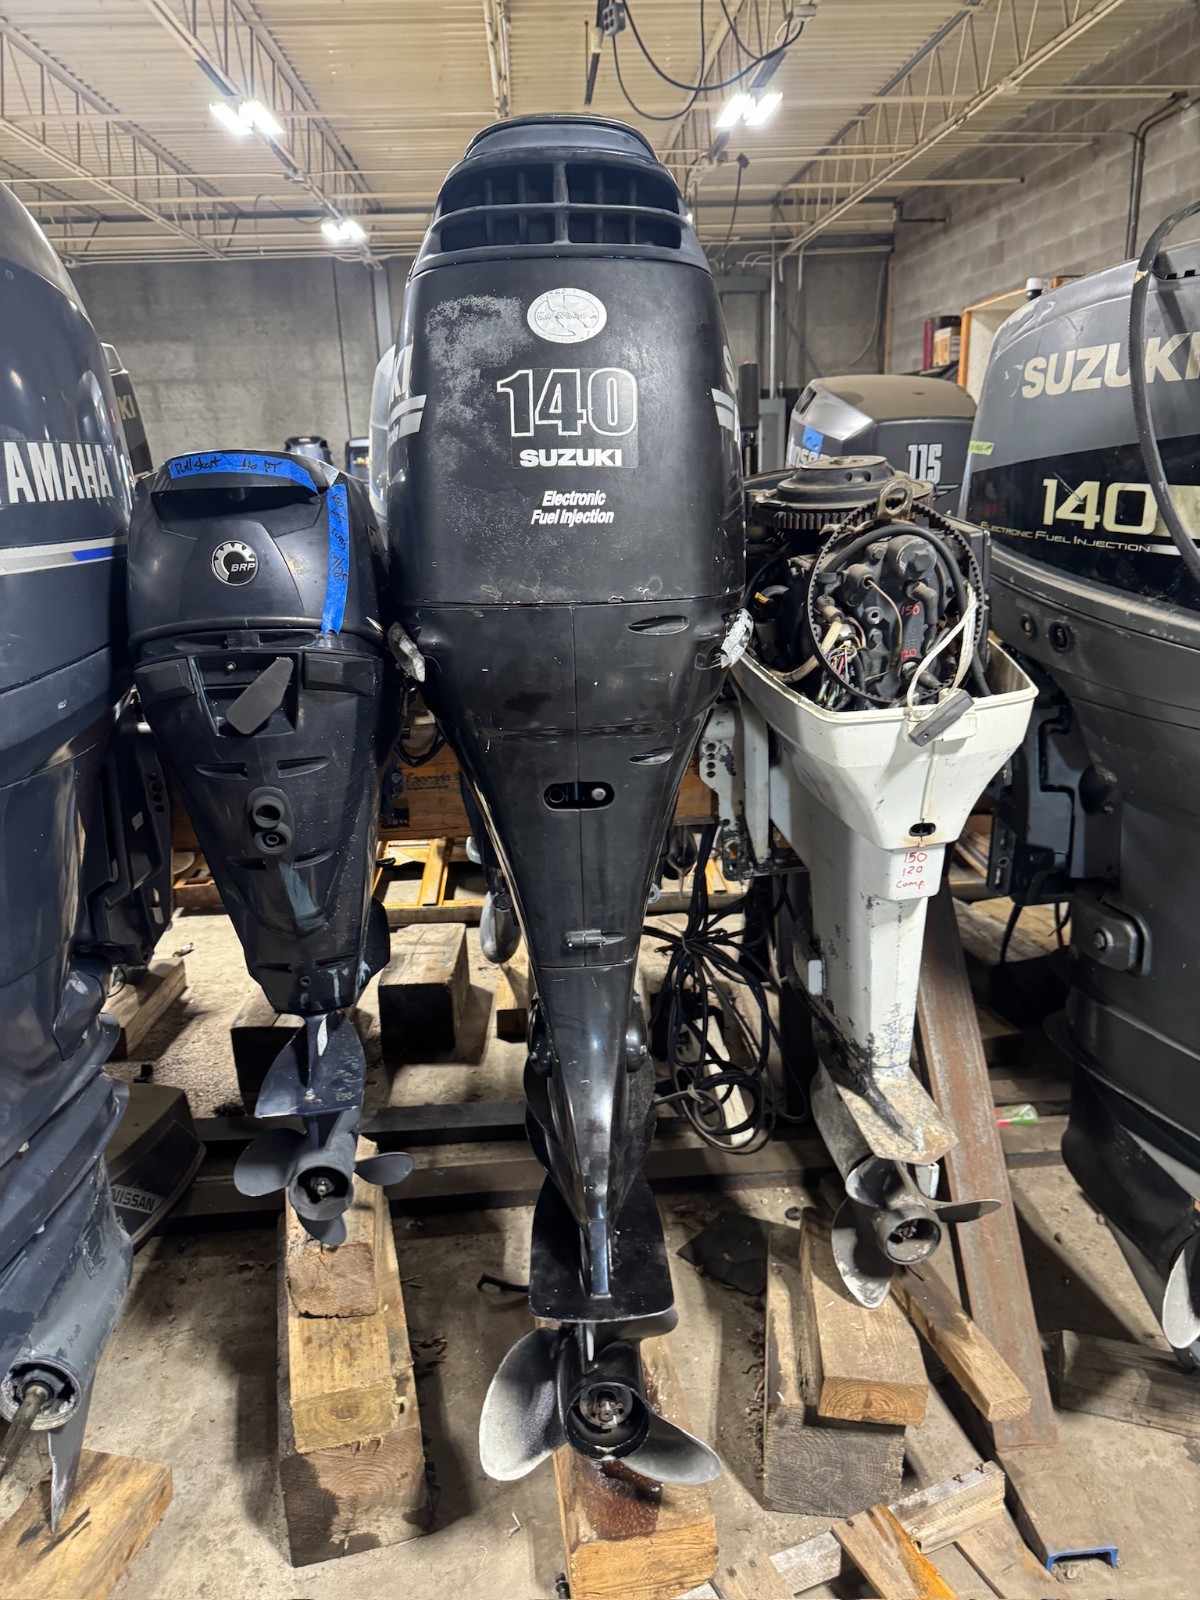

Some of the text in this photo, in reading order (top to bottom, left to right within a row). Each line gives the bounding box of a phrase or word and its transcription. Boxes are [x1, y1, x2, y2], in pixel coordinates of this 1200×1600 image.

[1021, 331, 1200, 399] SUZUKI
[497, 367, 638, 437] 140
[174, 457, 192, 475] Pull
[519, 448, 622, 468] SUZUKI
[907, 443, 943, 486] 115
[0, 441, 114, 504] AMAHA
[541, 490, 607, 507] Electronic
[1042, 478, 1159, 536] 140
[530, 508, 615, 528] Fuel Injection
[231, 562, 256, 573] BRP
[901, 603, 921, 616] 150
[903, 852, 928, 863] 150
[902, 865, 923, 877] 120
[111, 1187, 155, 1212] NISSAN
